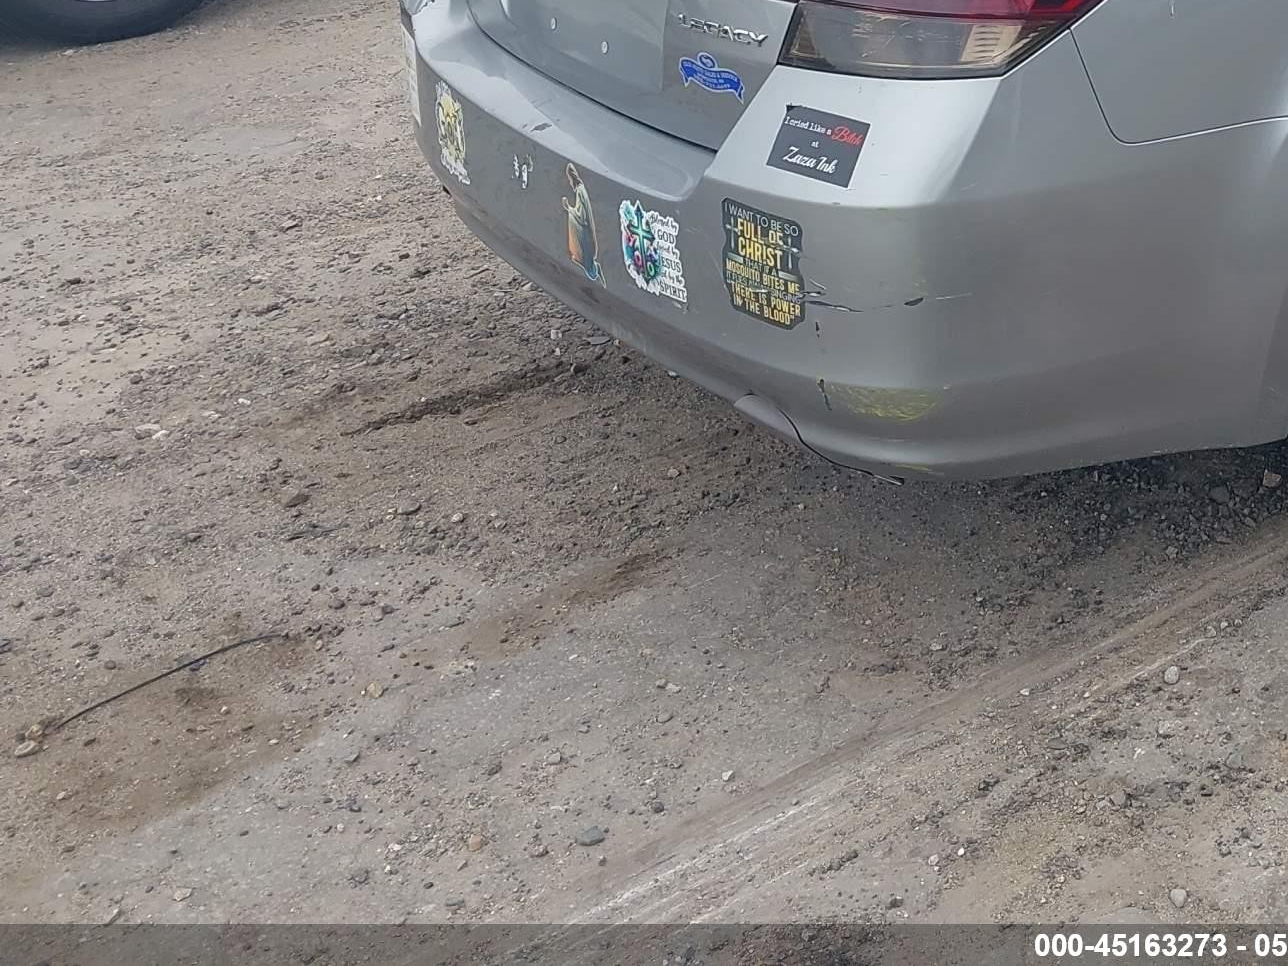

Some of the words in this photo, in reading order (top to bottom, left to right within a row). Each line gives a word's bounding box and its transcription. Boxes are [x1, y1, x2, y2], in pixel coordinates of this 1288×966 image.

[678, 13, 769, 47] LEGACY
[810, 122, 825, 134] like
[811, 140, 820, 148] at
[782, 146, 817, 168] Zaza
[816, 156, 839, 174] Ink
[729, 203, 754, 223] WANT
[756, 213, 769, 228] TO
[770, 219, 782, 233] BE
[784, 223, 799, 237] SO
[737, 217, 765, 244] FULL
[657, 229, 675, 244] GOD
[738, 236, 783, 270] CHRIST
[726, 257, 761, 283] MOSQUITO
[762, 273, 785, 291] BITES
[787, 281, 800, 294] ME
[660, 280, 687, 301] SPIRIT
[744, 297, 760, 315] THE
[759, 292, 767, 305] IS
[770, 296, 801, 317] POWER
